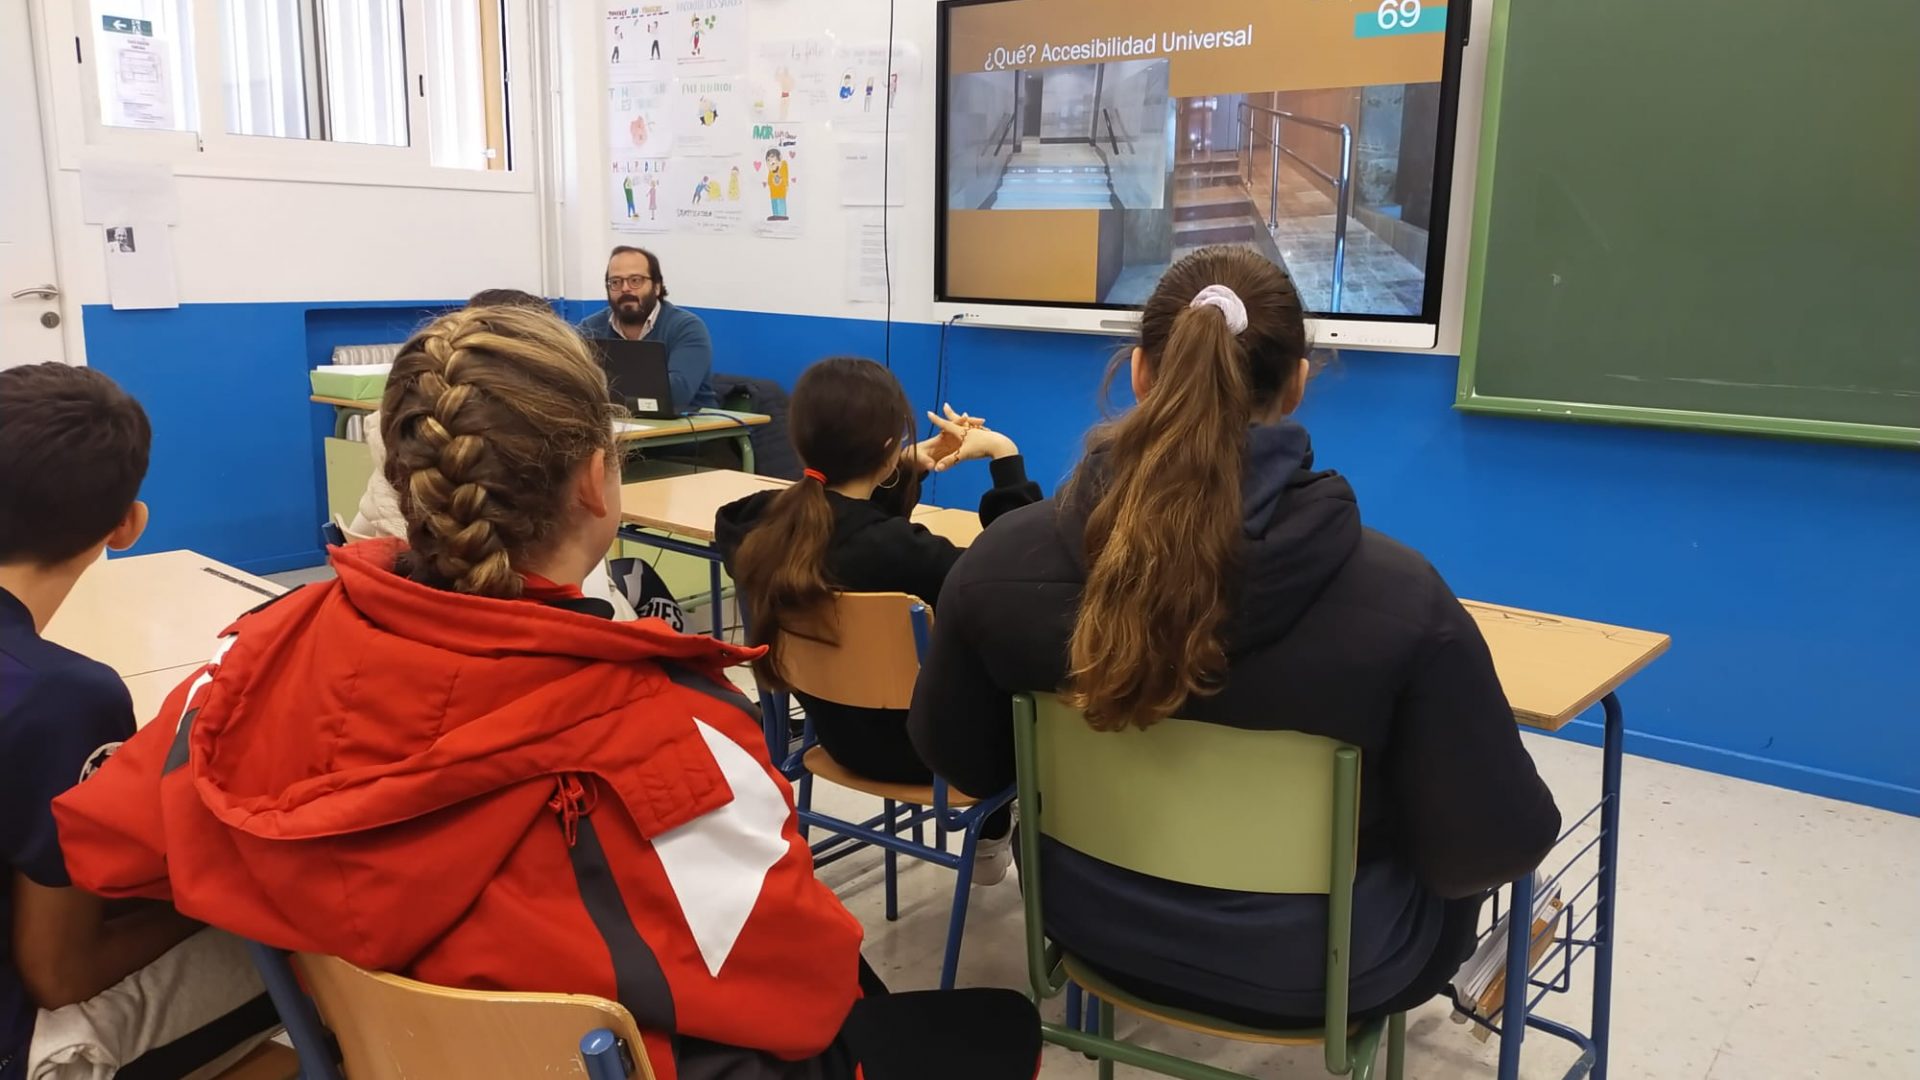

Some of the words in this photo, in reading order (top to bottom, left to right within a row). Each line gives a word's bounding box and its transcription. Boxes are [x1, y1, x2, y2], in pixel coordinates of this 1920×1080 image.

[1377, 0, 1421, 30] 69
[984, 44, 1037, 71] ¿Qué?
[1040, 33, 1156, 62] Accesibilidad
[1162, 24, 1253, 52] Universal
